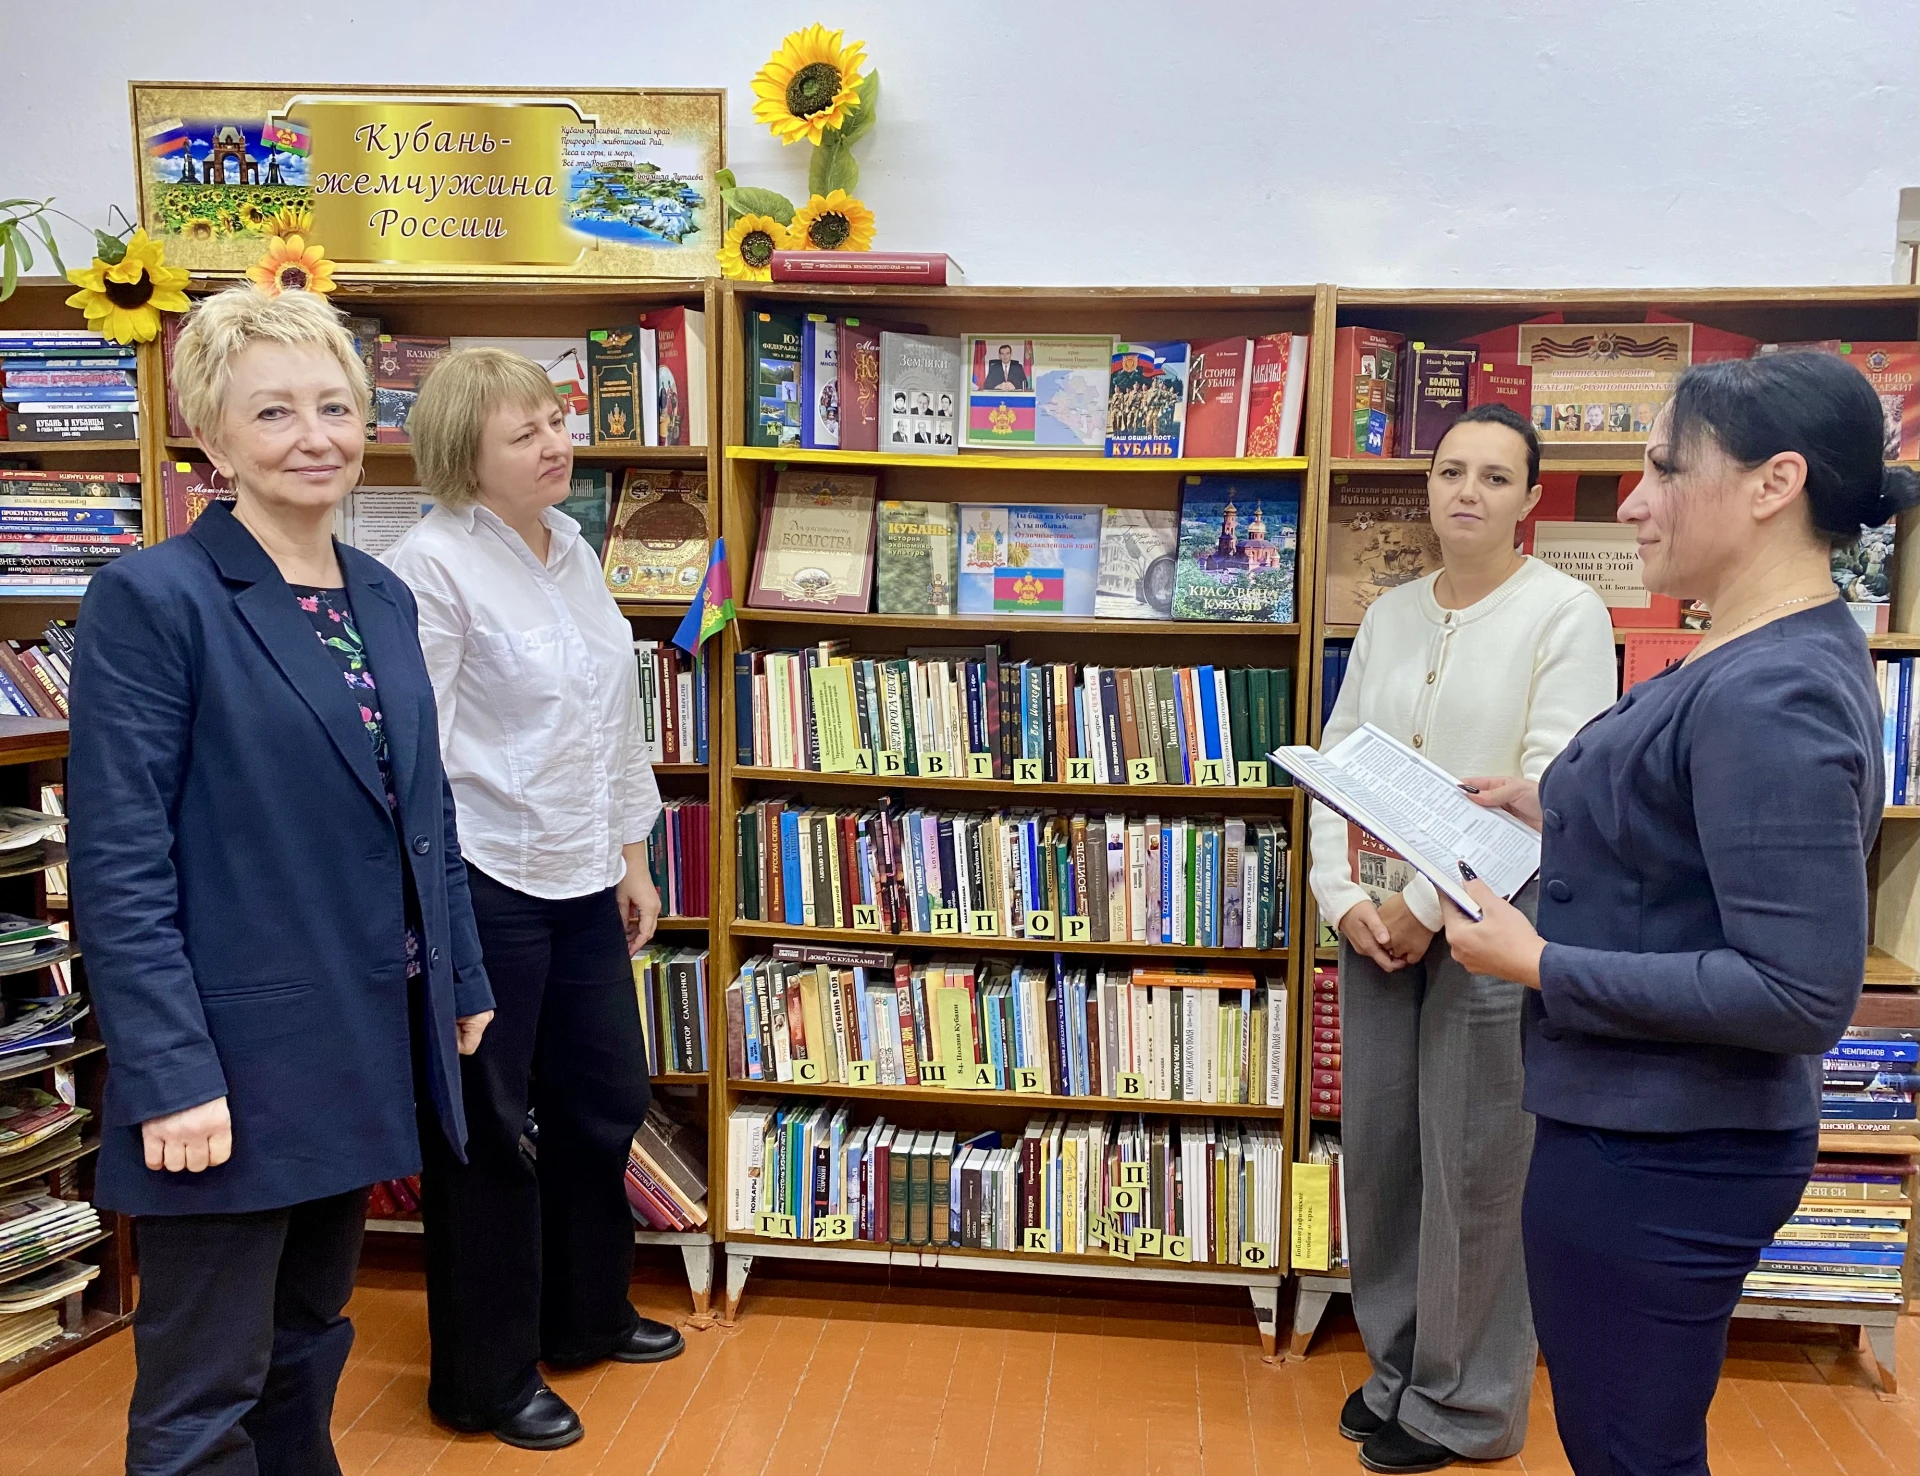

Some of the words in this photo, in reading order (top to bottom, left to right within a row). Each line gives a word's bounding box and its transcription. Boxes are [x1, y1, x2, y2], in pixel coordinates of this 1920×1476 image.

[354, 122, 511, 158] Кубань-
[561, 127, 585, 135] Кубань
[654, 129, 672, 138] край,
[561, 137, 595, 147] Природой
[315, 173, 557, 204] жемчужина
[368, 210, 507, 239] России
[406, 349, 440, 358] КАЗАКИ
[899, 354, 948, 370] Земляки
[1429, 377, 1460, 388] КОЛЬЧУГА
[1425, 388, 1462, 397] СВЯТОСЛАВА
[1496, 387, 1518, 395] ЗВЕЗДЫ
[36, 419, 62, 427] КУБАНЬ
[71, 418, 104, 426] КУБАНЦЫ
[1113, 442, 1172, 456] КУБАНЬ
[1341, 495, 1379, 504] Кубани
[1382, 497, 1388, 505] и
[1055, 513, 1086, 521] Кубани?
[888, 522, 951, 536] КУБАНЬ:
[782, 533, 852, 549] БОГАТСТВА
[89, 545, 120, 554] фронта
[1541, 551, 1560, 559] ЭТО
[1564, 551, 1595, 560] НАША
[1605, 562, 1634, 570] ЭТОЙ
[1218, 678, 1228, 731] Драгомиров
[1166, 699, 1179, 749] Знаменский
[1111, 741, 1119, 764] ПЕРВОГО
[1222, 732, 1232, 778] Александр
[884, 755, 899, 771] Б
[927, 757, 943, 772] В
[973, 757, 987, 773] Г
[1070, 763, 1090, 778] И
[1136, 763, 1149, 779] З
[1020, 764, 1036, 779] К
[1201, 764, 1220, 784] Д
[1243, 766, 1261, 782] Л
[1077, 842, 1087, 893] ВОИТЕЛЬ
[1227, 847, 1239, 888] РЕЛИКВИЯ
[856, 909, 875, 925] М
[935, 913, 953, 929] Н
[976, 915, 994, 931] П
[1032, 915, 1049, 931] О
[1070, 921, 1084, 936] Р
[837, 957, 875, 965] КУЛАКАМИ
[745, 974, 753, 1004] РУНОВ
[756, 976, 765, 995] РУНОВ
[831, 976, 839, 997] МОЯ
[680, 972, 690, 1020] САЛОШЕНКО
[759, 995, 769, 1024] Владимир
[834, 998, 843, 1033] КУБАНЬ
[748, 1006, 757, 1039] Владимир
[684, 1025, 692, 1055] ВИКТОР
[901, 1027, 914, 1041] ЗОРИ
[955, 1033, 963, 1061] Поэзия
[1842, 1048, 1885, 1056] ЧЕМПИОНОВ
[903, 1044, 917, 1077] КУБАНСКИЕ
[800, 1064, 815, 1080] С
[854, 1065, 869, 1081] Т
[975, 1069, 991, 1084] А
[1021, 1072, 1036, 1087] Б
[1123, 1077, 1139, 1093] В
[1125, 1166, 1145, 1183] П
[1116, 1191, 1133, 1208] О
[761, 1216, 774, 1232] Г
[832, 1219, 846, 1235] З
[1092, 1218, 1107, 1237] Л
[1295, 1192, 1303, 1257] Библиографические
[1030, 1233, 1046, 1249] К
[1113, 1236, 1130, 1255] Н
[1140, 1233, 1155, 1249] Р
[1169, 1240, 1185, 1257] С
[1245, 1246, 1265, 1263] Ф
